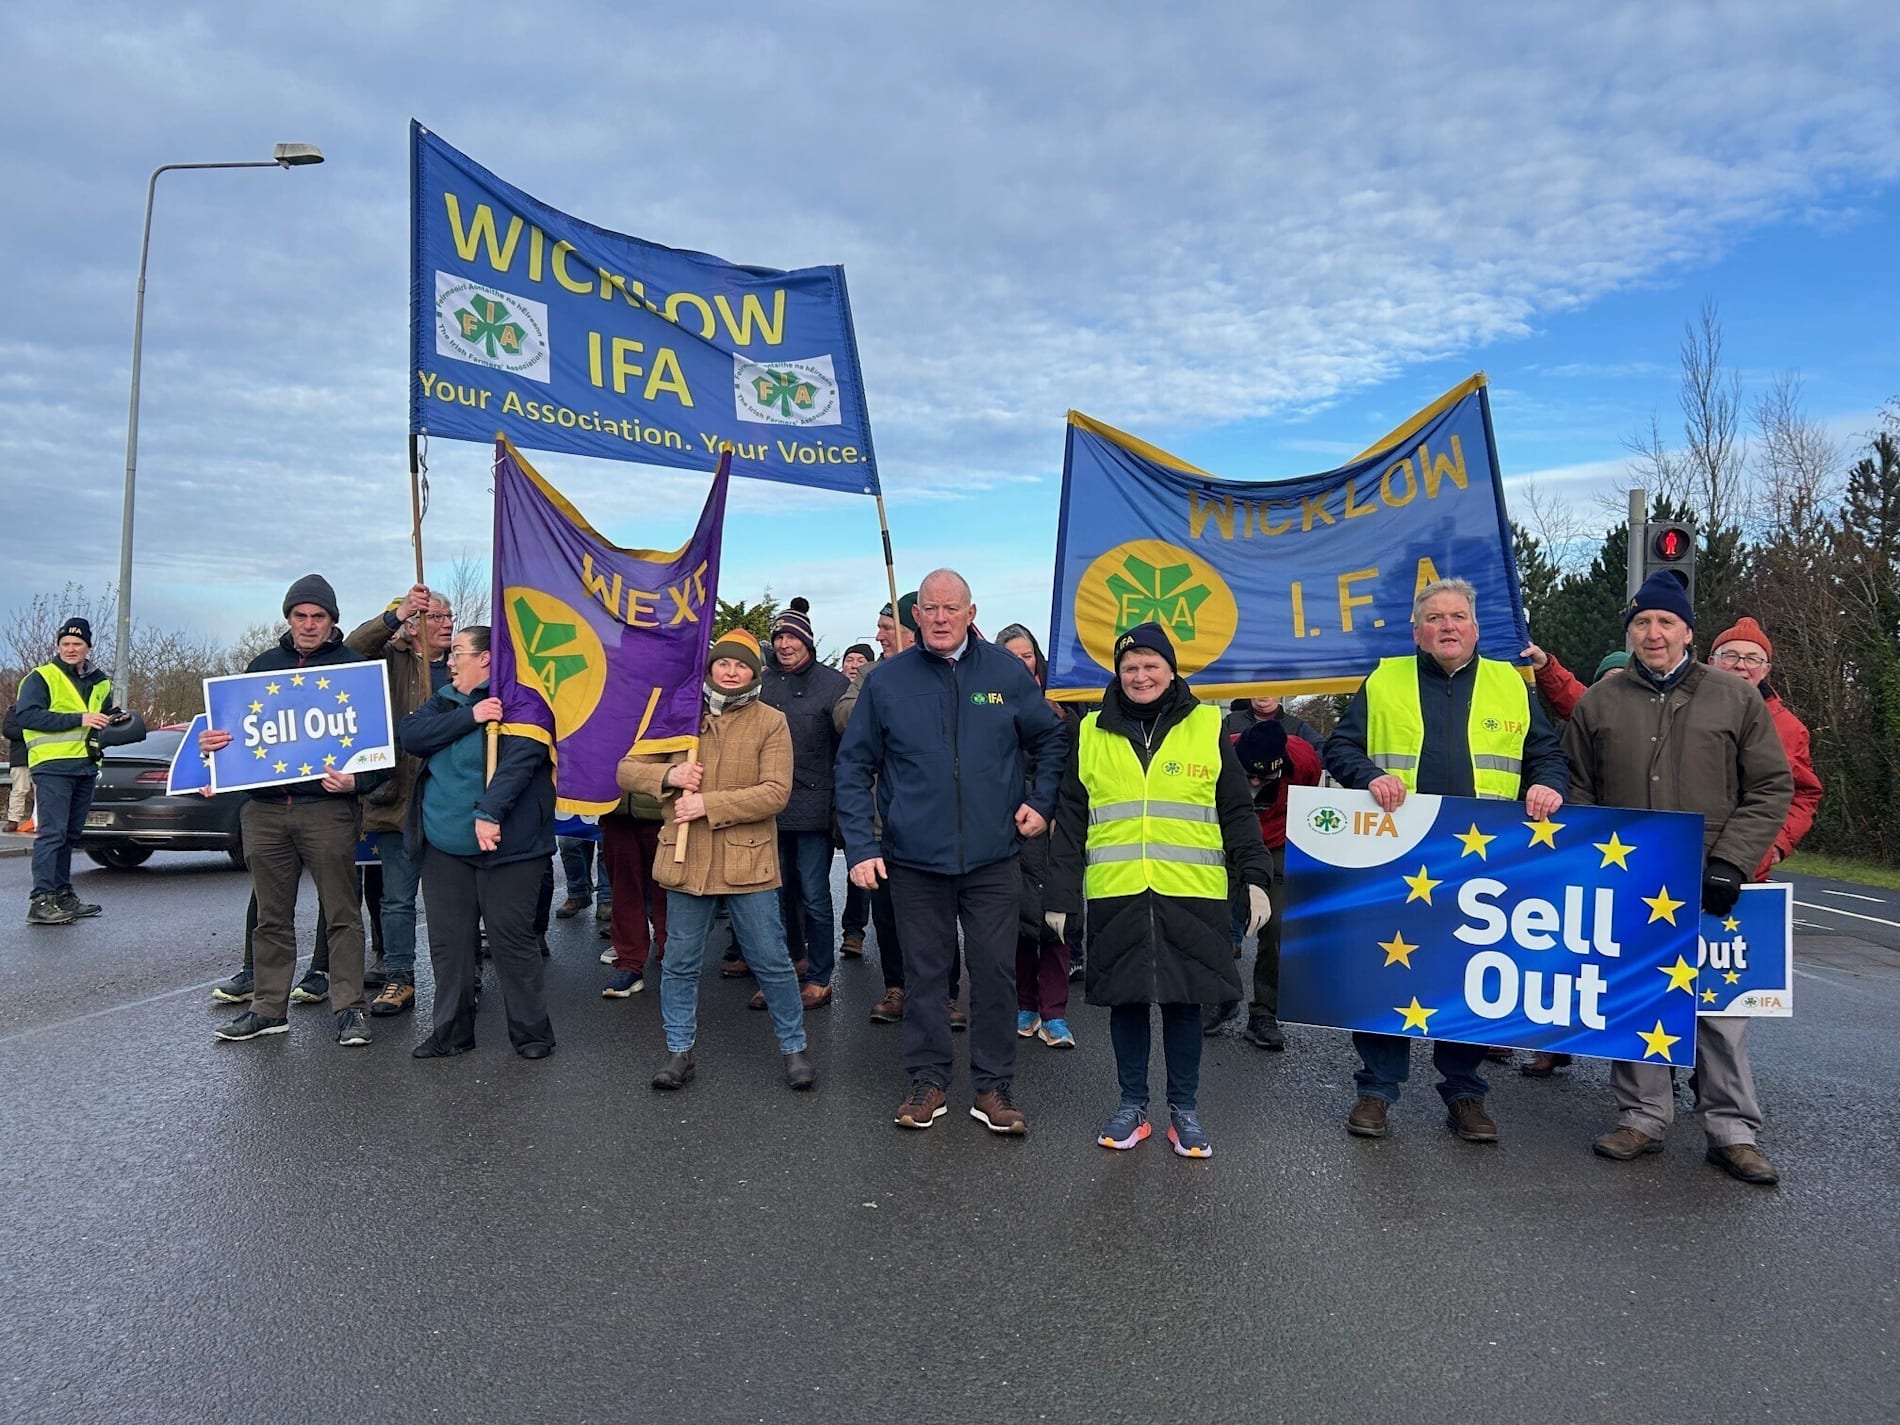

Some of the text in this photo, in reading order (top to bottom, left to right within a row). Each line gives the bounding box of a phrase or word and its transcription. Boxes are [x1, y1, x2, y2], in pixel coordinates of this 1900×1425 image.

[588, 331, 694, 407] IFA
[418, 370, 868, 464] Your Association. Your Voice.
[1188, 435, 1468, 540] WICKLOW
[68, 627, 83, 635] IFA
[1120, 635, 1135, 650] IFA
[988, 693, 1004, 704] IFA
[243, 706, 358, 747] Sell Out
[1504, 720, 1523, 735] IFA
[369, 752, 386, 763] IFA
[1187, 763, 1210, 779] IFA
[1353, 811, 1399, 838] IFA
[1452, 877, 1621, 957] Sell
[1464, 950, 1607, 1030] Out
[1760, 996, 1782, 1008] IFA
